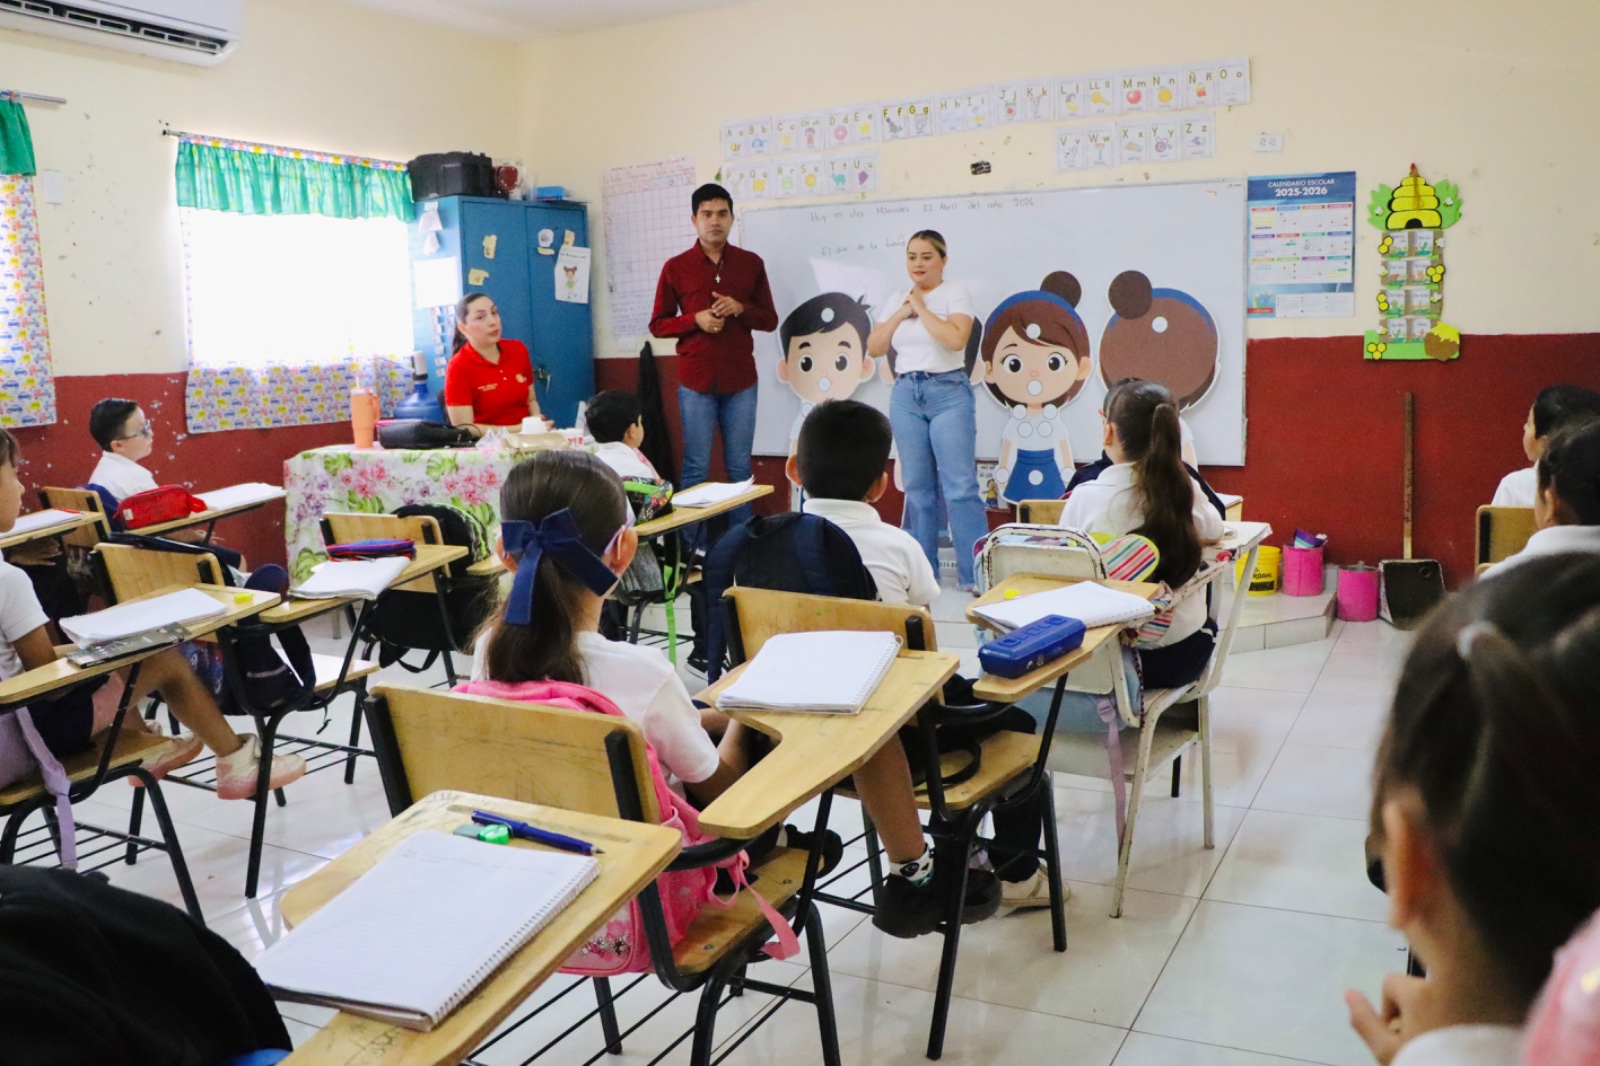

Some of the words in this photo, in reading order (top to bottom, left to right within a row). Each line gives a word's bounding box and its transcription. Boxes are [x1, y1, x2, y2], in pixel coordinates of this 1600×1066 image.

[749, 126, 754, 134] B
[761, 125, 767, 133] b
[777, 123, 783, 131] C
[830, 116, 836, 125] D
[843, 115, 848, 124] d
[854, 113, 859, 121] E
[883, 108, 889, 118] F
[897, 107, 902, 116] f
[909, 105, 916, 114] G
[922, 106, 928, 115] g
[955, 100, 960, 108] h
[968, 97, 972, 106] I
[999, 90, 1006, 100] J
[1012, 90, 1017, 101] j
[1026, 88, 1033, 97] K
[1042, 87, 1047, 97] k
[1060, 86, 1066, 94] L
[1123, 79, 1132, 88] M
[1153, 76, 1160, 86] N
[1189, 72, 1196, 84] Ñ
[1220, 69, 1227, 79] O
[1060, 137, 1067, 146] V
[1088, 134, 1099, 143] W
[1122, 129, 1128, 138] X
[1152, 127, 1158, 136] Y
[1168, 130, 1174, 138] y
[1186, 123, 1192, 133] Z
[750, 170, 756, 178] Q
[778, 167, 783, 175] R
[801, 165, 806, 173] S
[830, 162, 835, 171] T
[854, 160, 860, 169] U
[1275, 187, 1327, 196] 2025-2026
[810, 212, 826, 223] Hoy
[923, 203, 933, 212] 22
[968, 201, 980, 210] del
[987, 201, 1003, 209] año
[1013, 197, 1034, 207] 2026
[821, 247, 831, 256] El
